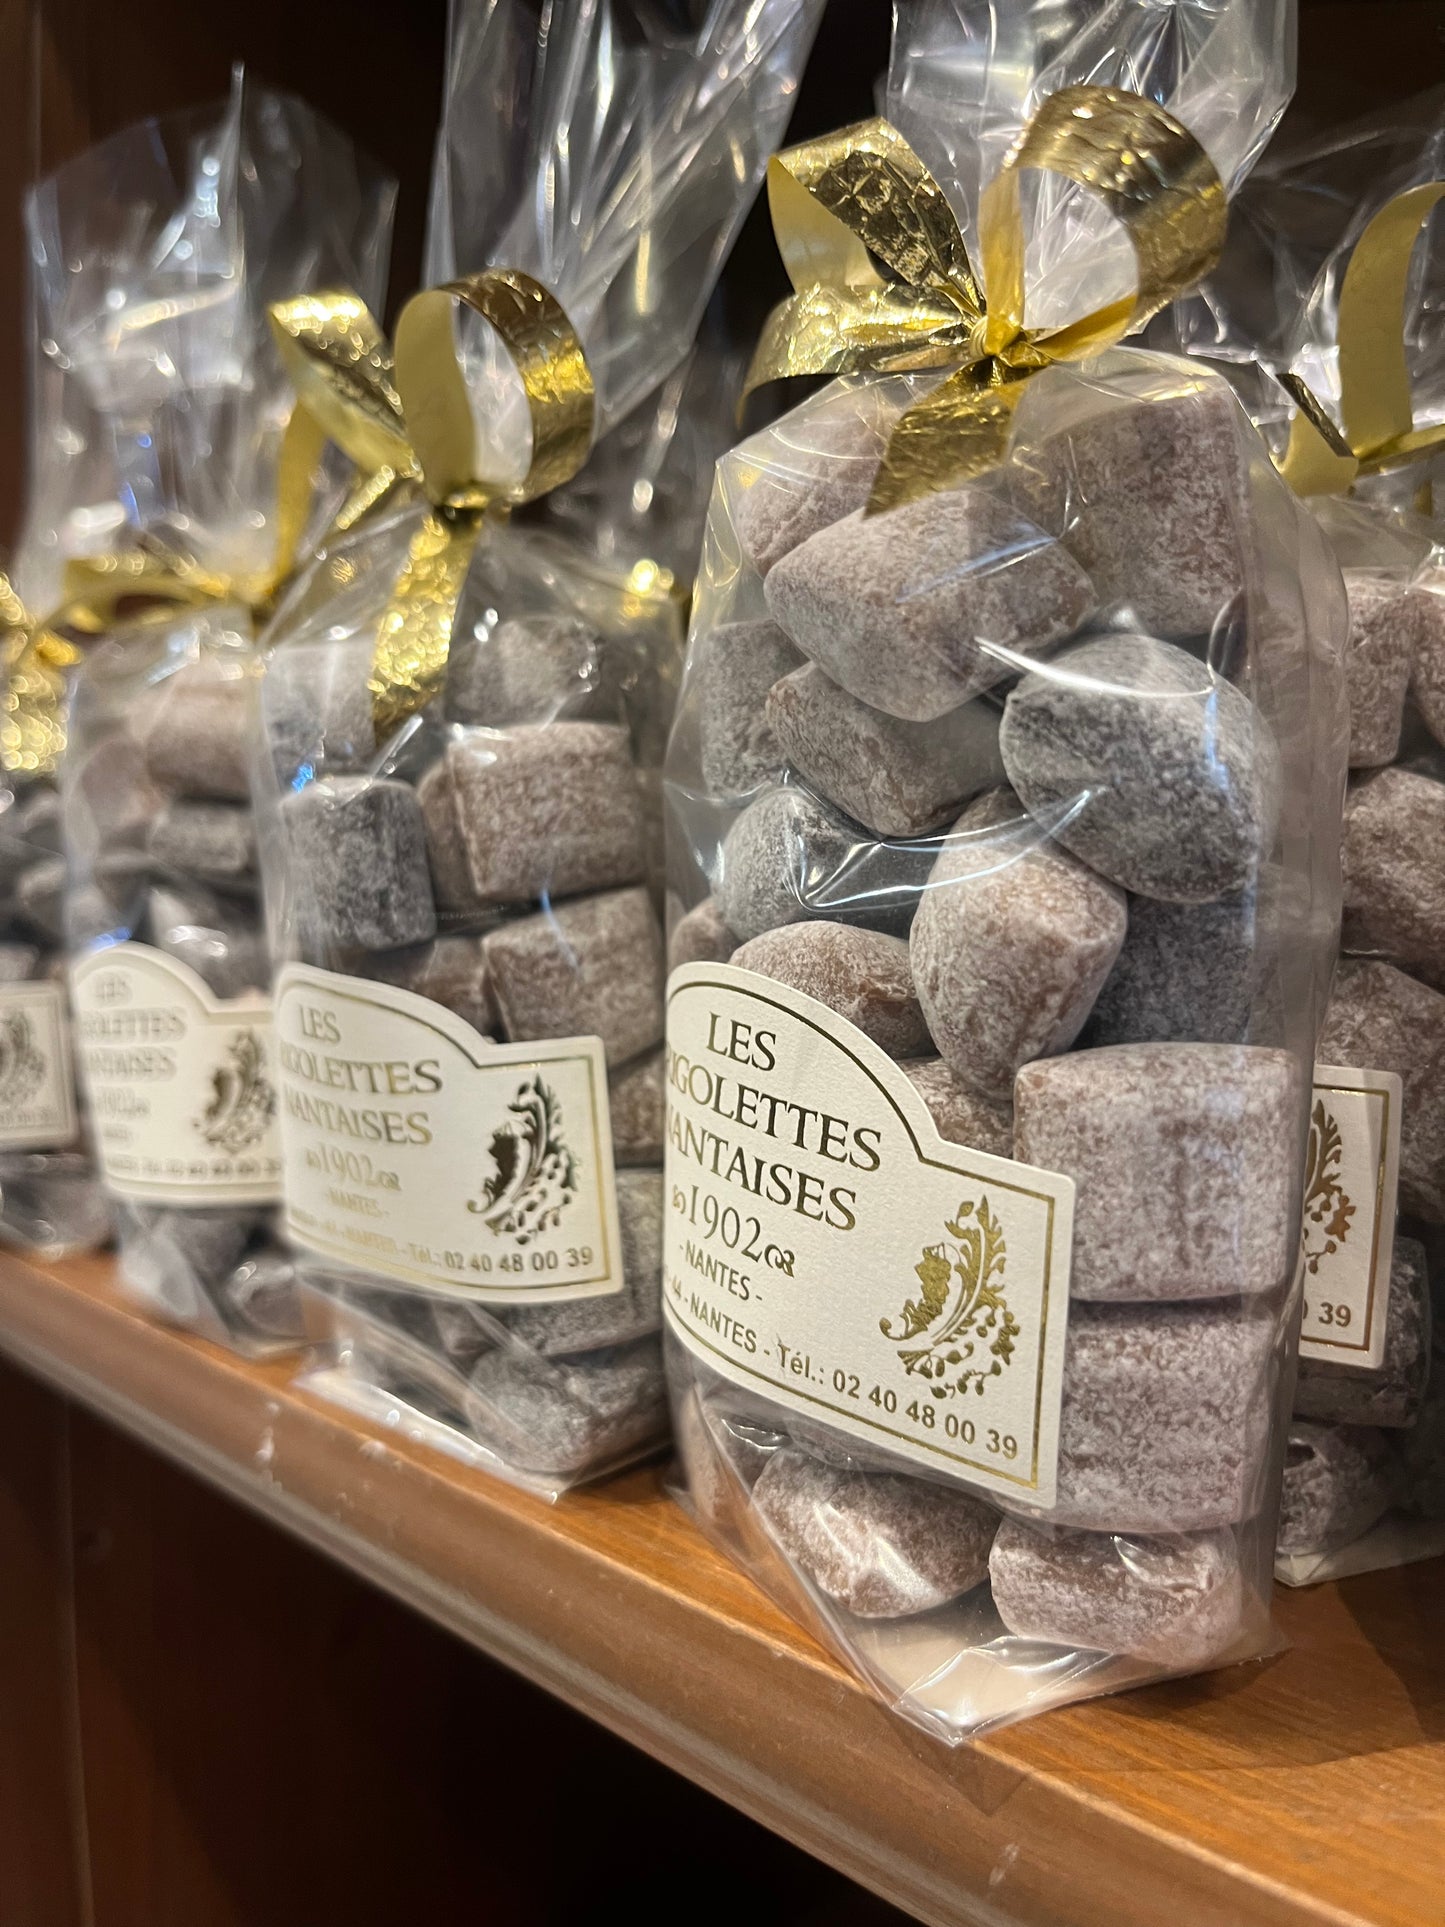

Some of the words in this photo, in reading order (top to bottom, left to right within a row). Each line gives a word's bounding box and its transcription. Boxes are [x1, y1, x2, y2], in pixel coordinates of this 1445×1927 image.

[299, 1004, 341, 1044] LES
[705, 1011, 777, 1072] LES
[688, 1184, 763, 1263] 1902
[444, 1250, 464, 1272] 02
[470, 1253, 492, 1272] 40
[499, 1252, 524, 1272] 48
[531, 1250, 558, 1271] 00
[567, 1246, 593, 1267] 39
[685, 1239, 751, 1301] NANTES
[1318, 1301, 1352, 1328] 39
[690, 1292, 758, 1354] NANTES
[832, 1368, 860, 1400] 02
[868, 1384, 898, 1414] 40
[905, 1399, 936, 1429] 48
[944, 1413, 976, 1445] 00
[985, 1428, 1018, 1460] 39
